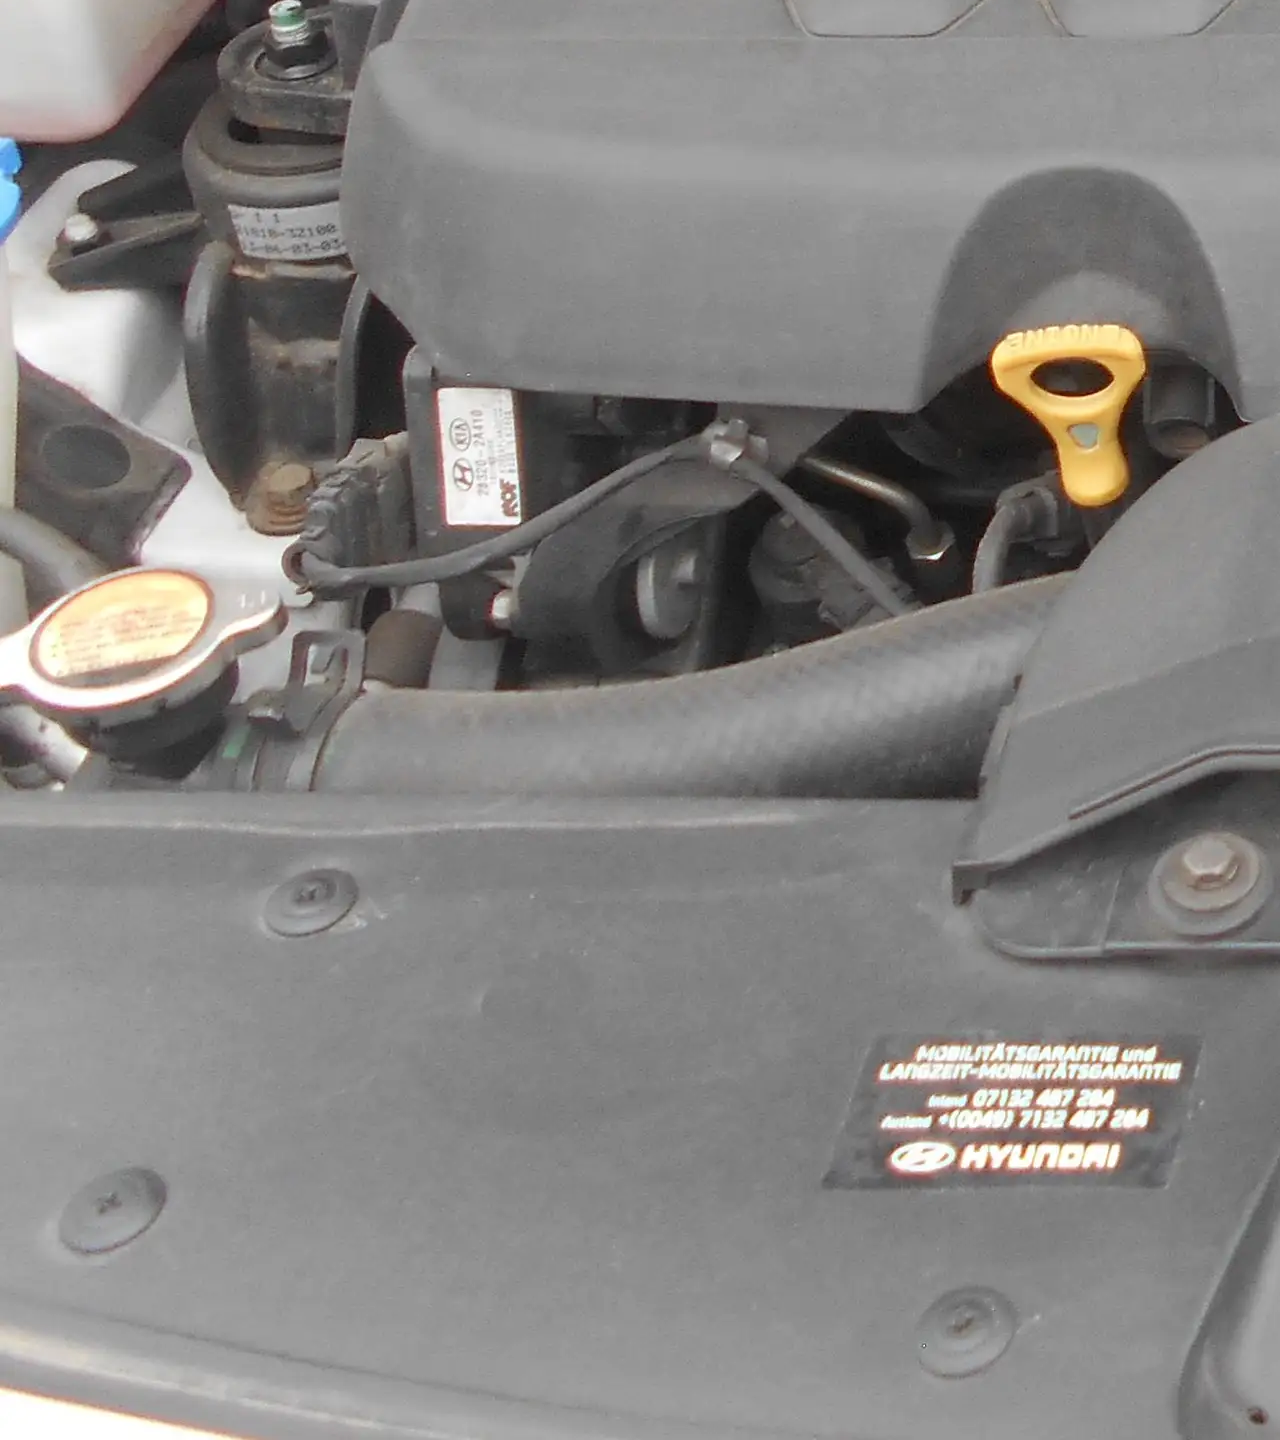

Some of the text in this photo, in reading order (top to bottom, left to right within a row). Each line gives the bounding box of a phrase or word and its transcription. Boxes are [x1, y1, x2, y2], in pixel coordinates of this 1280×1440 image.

[453, 421, 470, 448] KIA
[1122, 1046, 1157, 1063] und
[972, 1089, 1032, 1108] 07132
[959, 1143, 1121, 1170] HYUNDAI
